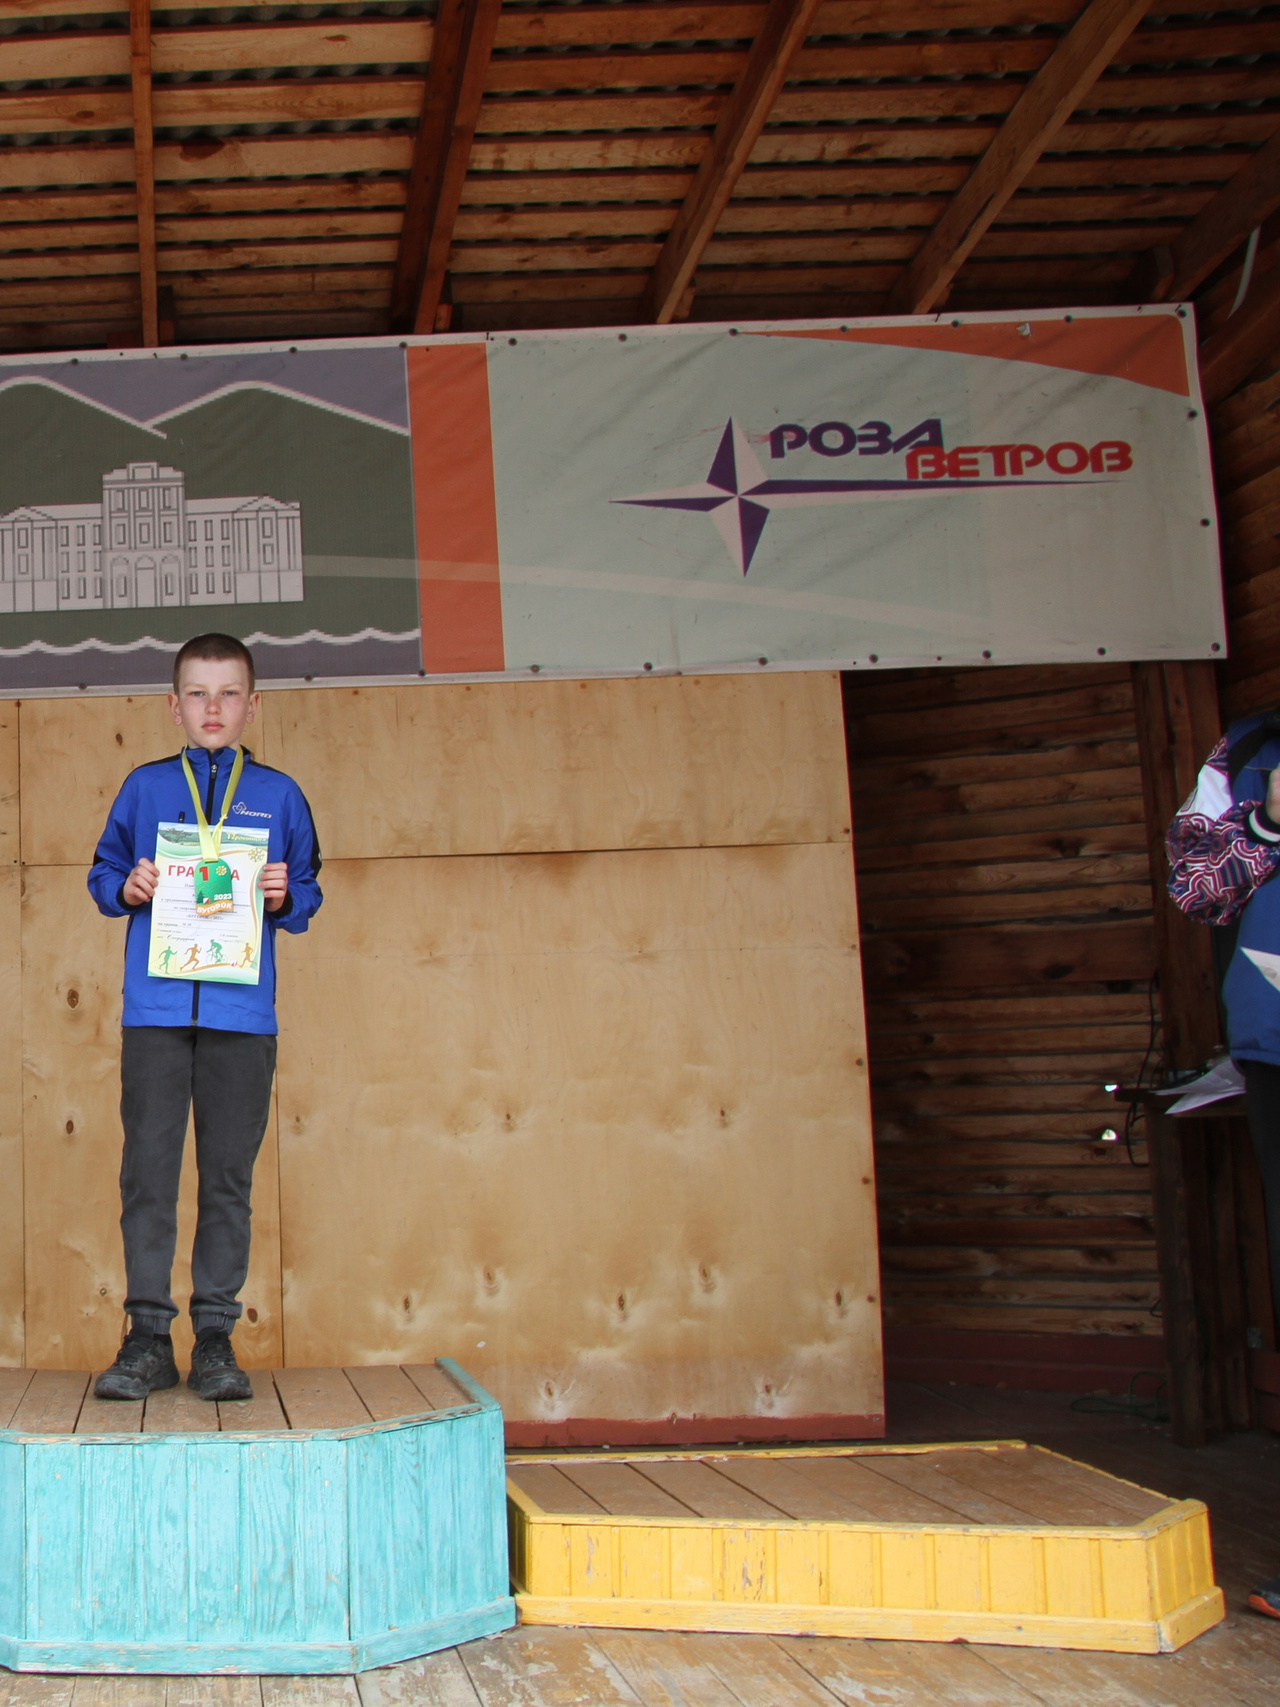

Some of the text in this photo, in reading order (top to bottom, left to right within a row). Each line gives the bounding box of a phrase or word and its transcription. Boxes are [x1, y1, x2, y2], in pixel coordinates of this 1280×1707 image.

[770, 418, 943, 459] РОЗА
[905, 440, 1133, 481] ВЕТРОВ
[240, 810, 272, 819] NORD
[168, 864, 240, 881] ГРАА
[199, 866, 209, 881] 1
[214, 893, 232, 901] 2023
